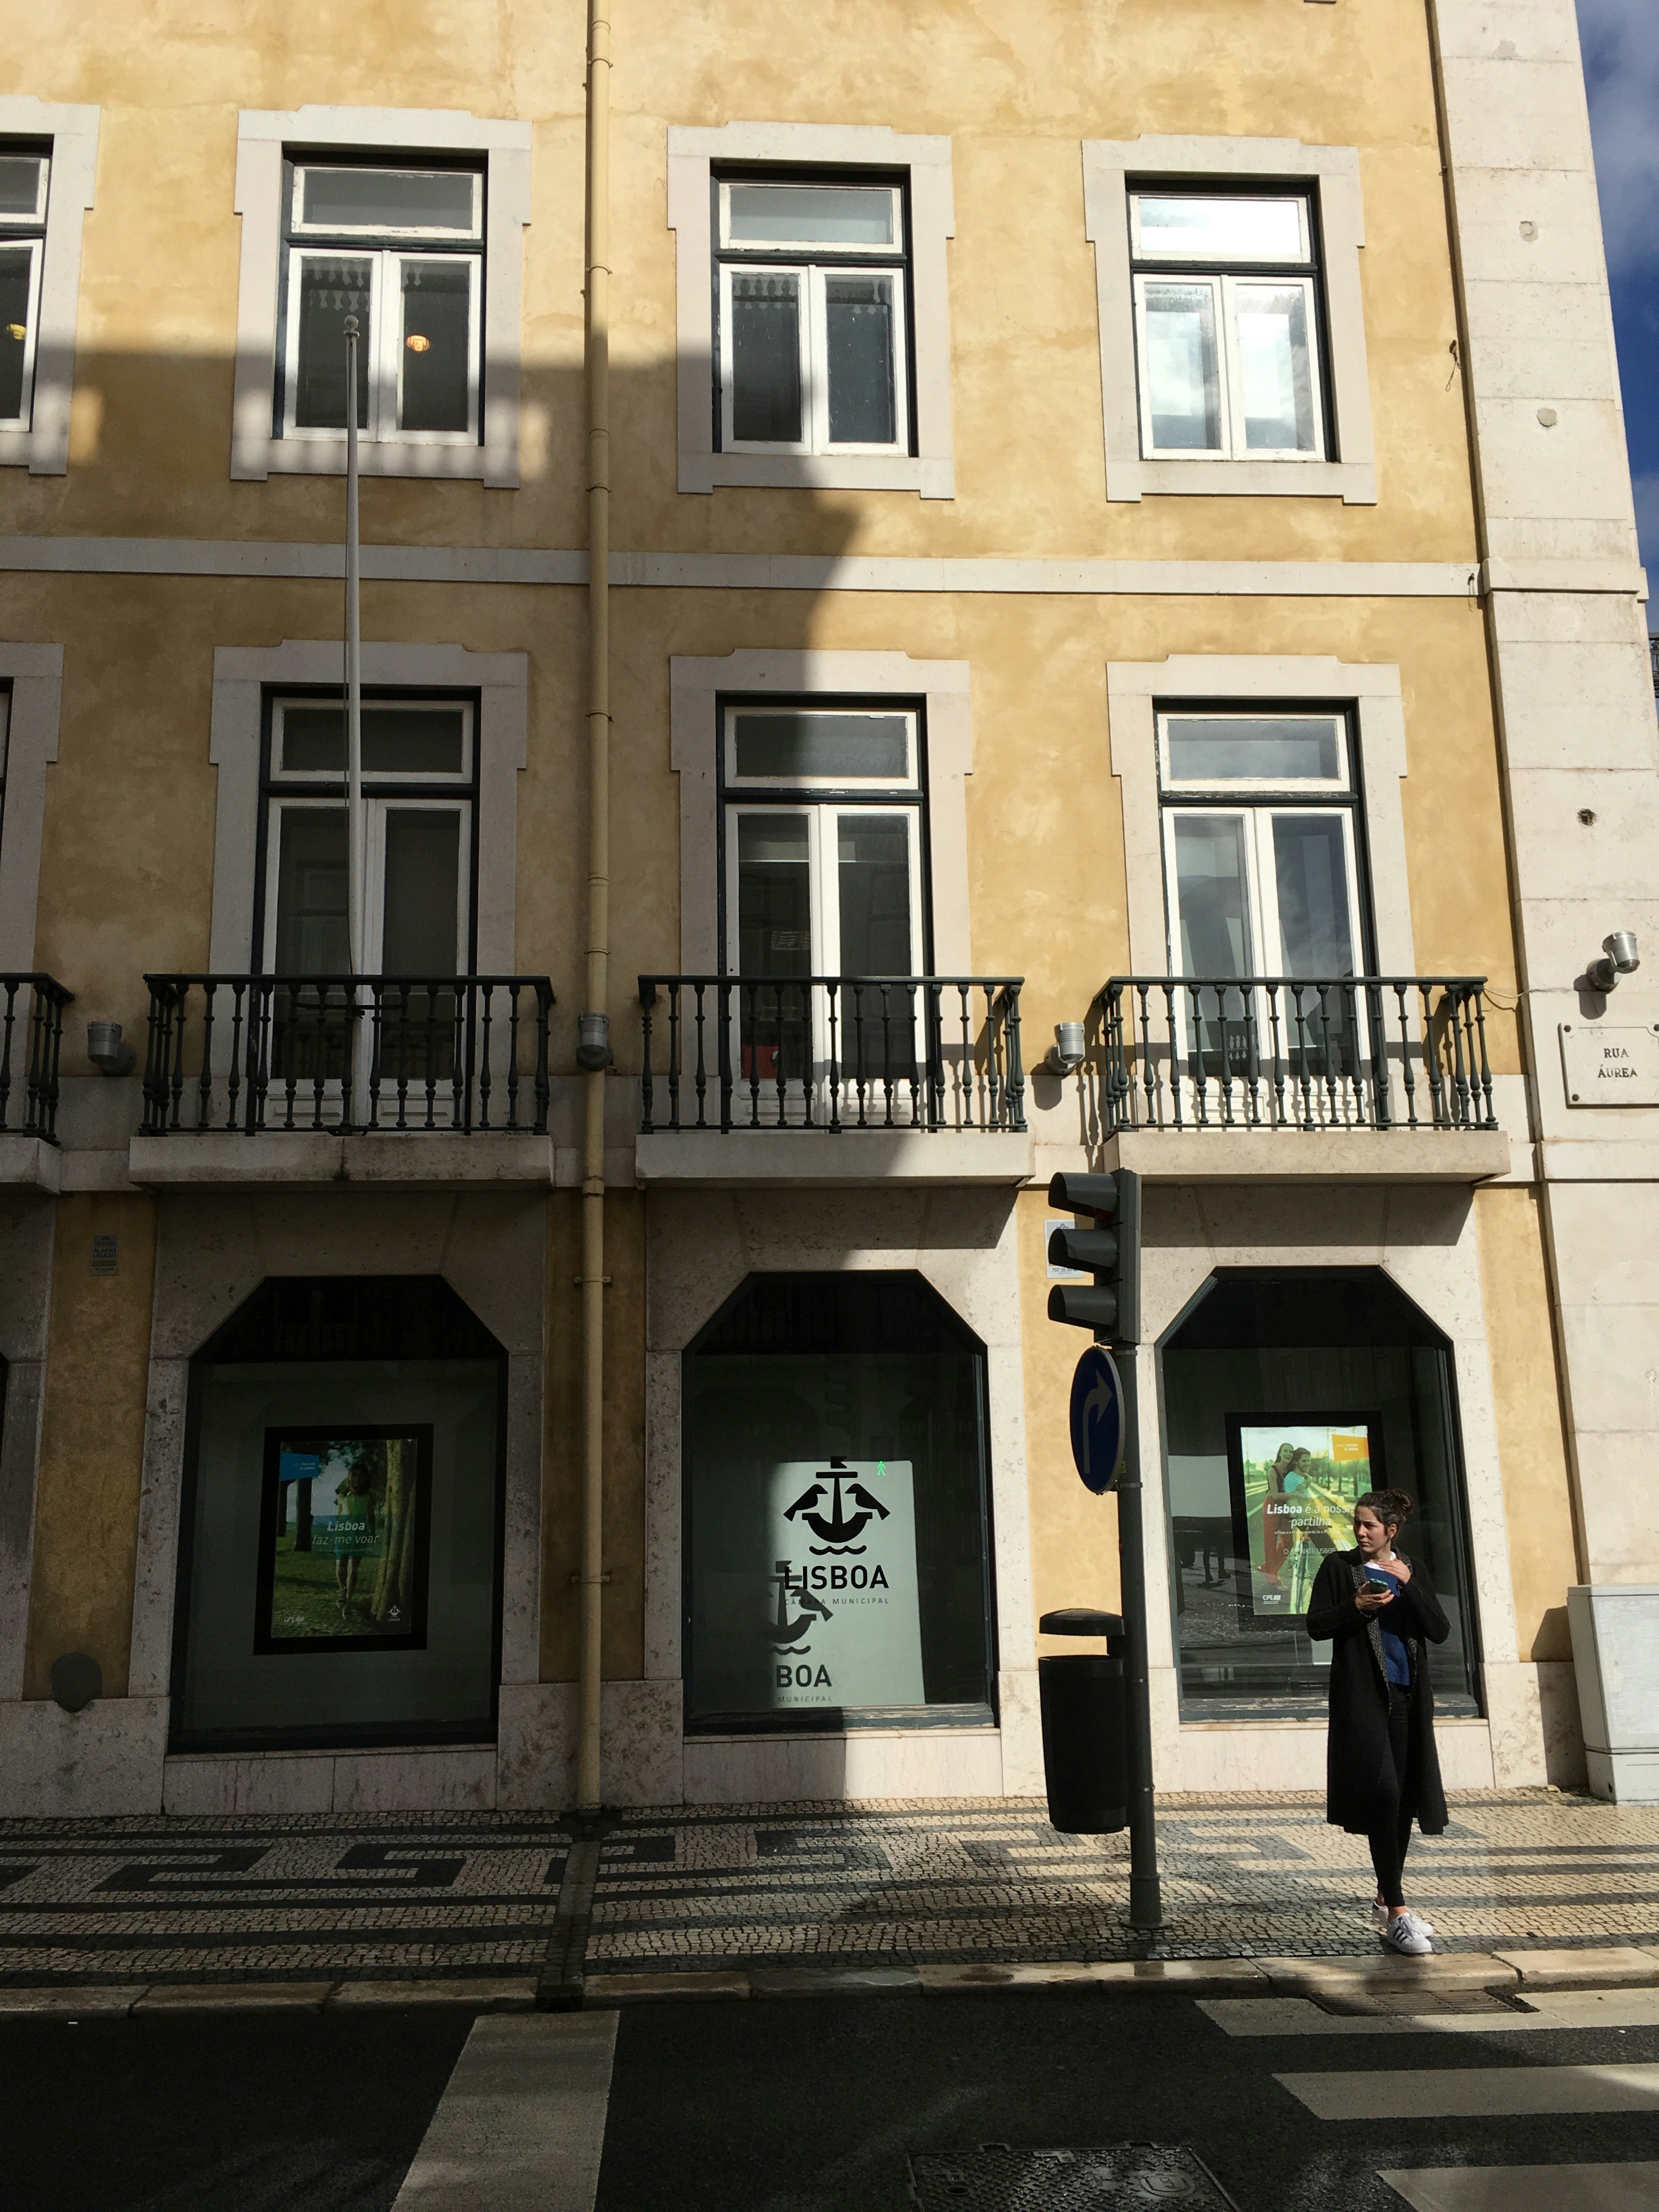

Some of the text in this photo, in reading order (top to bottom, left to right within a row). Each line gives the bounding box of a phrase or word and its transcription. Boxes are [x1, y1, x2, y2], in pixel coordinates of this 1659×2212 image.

[1603, 1048, 1630, 1058] RUA
[1597, 1064, 1638, 1078] ÁUREA
[1267, 1504, 1302, 1514] Lisboa
[1305, 1503, 1311, 1513] é
[327, 1521, 365, 1531] Lisboa
[1291, 1516, 1331, 1529] partilha
[355, 1535, 380, 1544] voar
[785, 1565, 889, 1590] LISBOA
